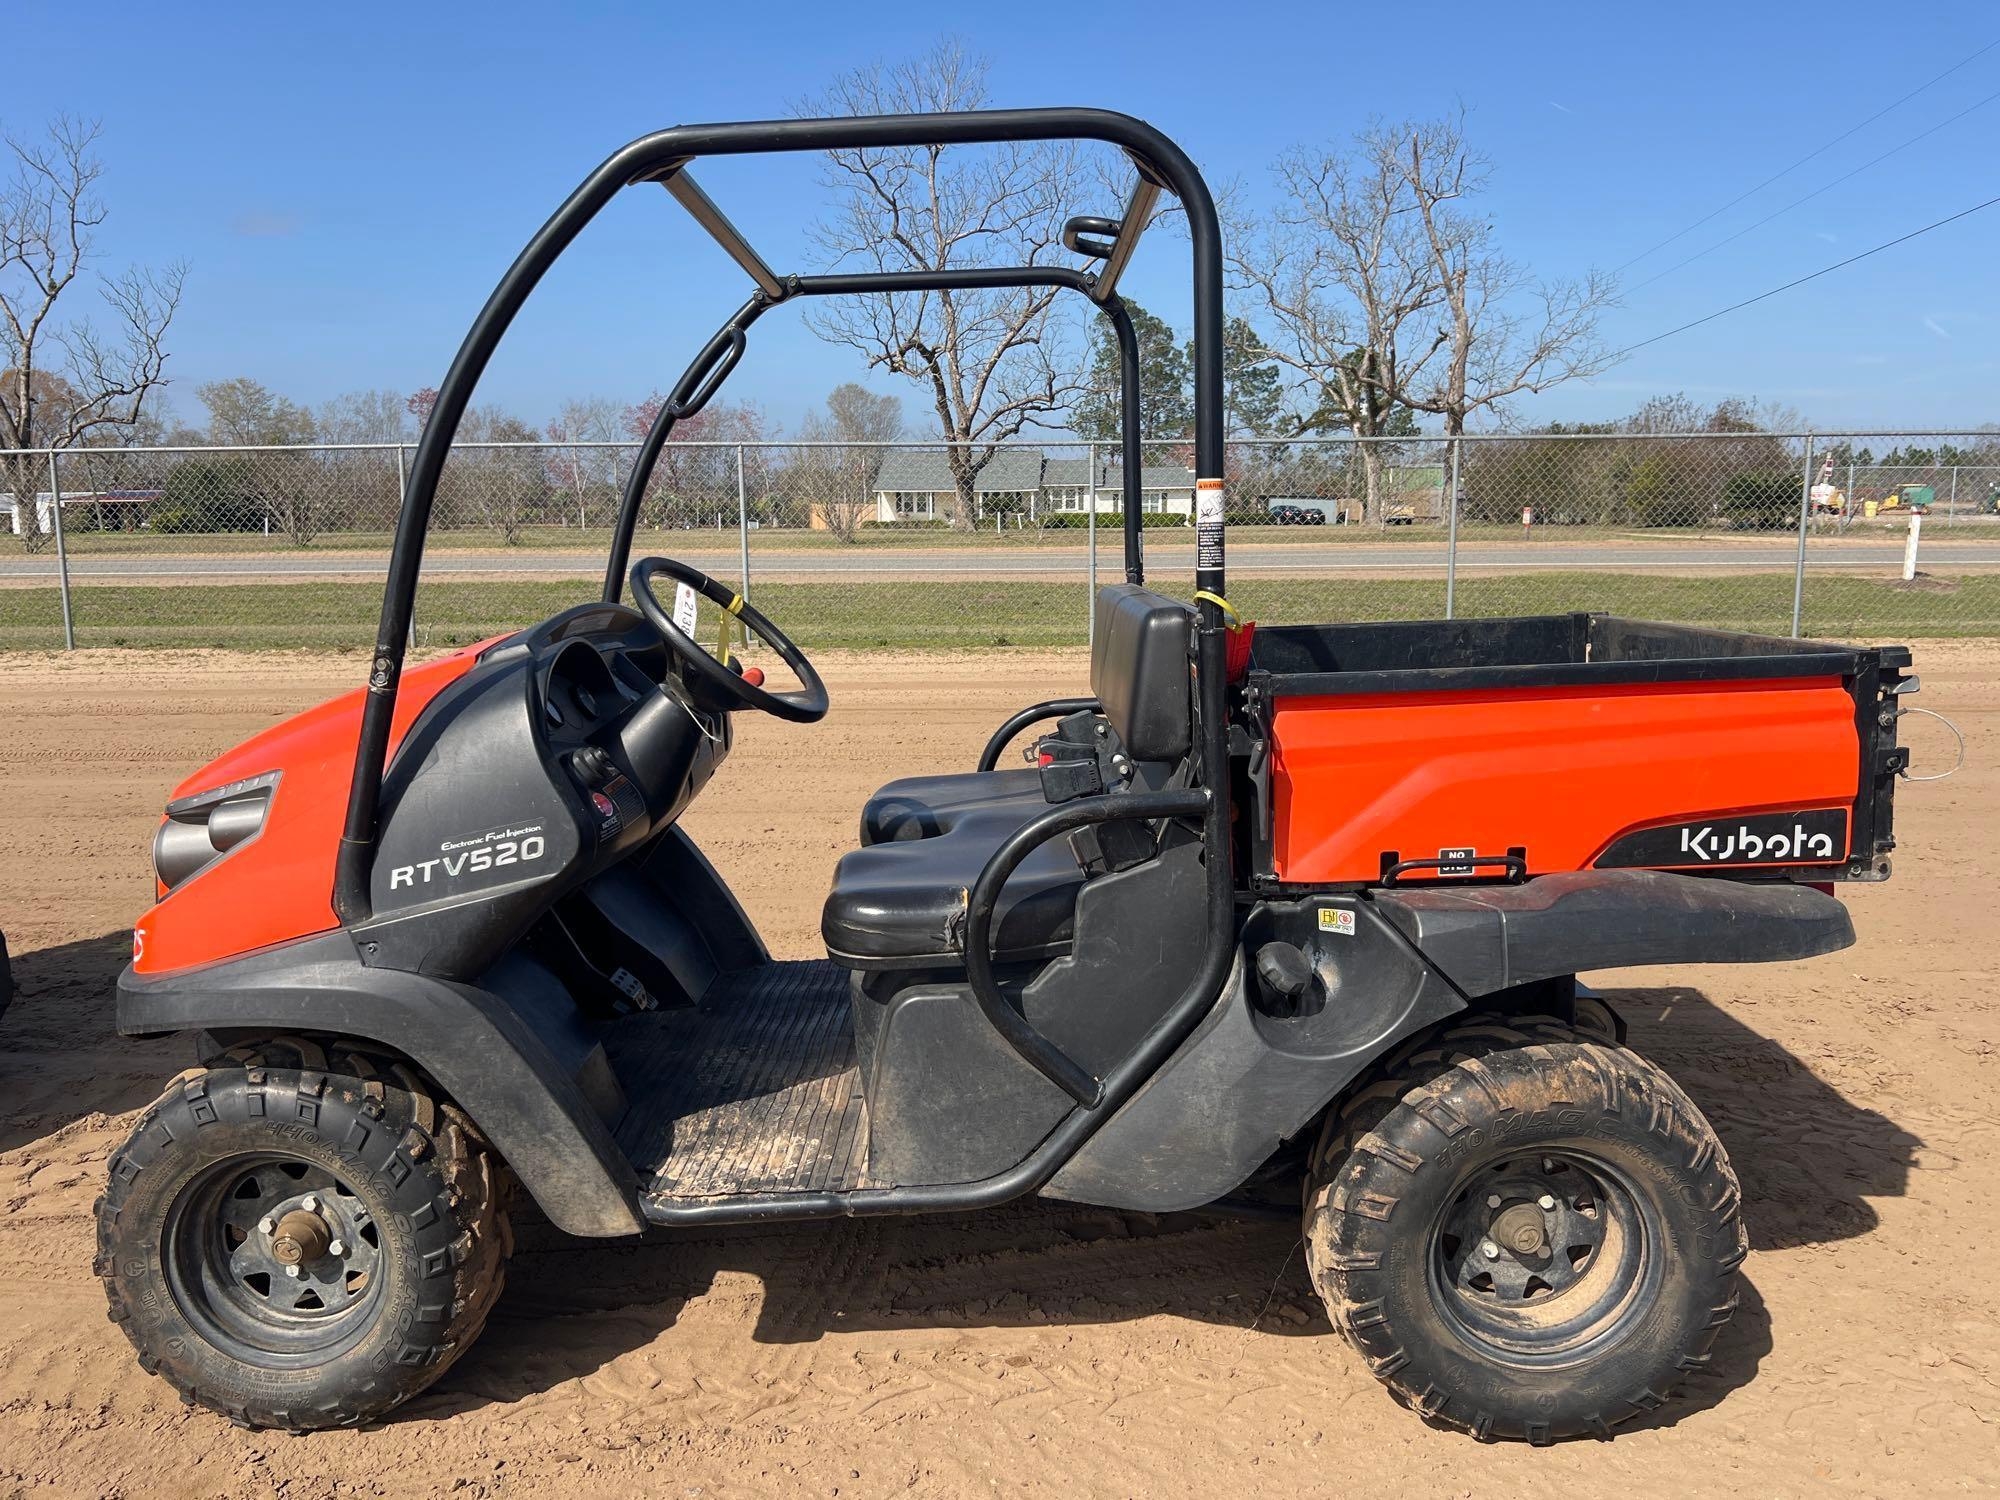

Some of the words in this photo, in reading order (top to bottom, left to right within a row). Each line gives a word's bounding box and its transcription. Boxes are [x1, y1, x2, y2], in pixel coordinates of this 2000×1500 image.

[441, 838, 485, 851] Electronic
[485, 832, 506, 842] Fuel
[506, 826, 542, 838] Injection
[1448, 851, 1465, 859] NO
[1681, 824, 1833, 860] Kubota
[390, 836, 545, 890] RTV520
[264, 1120, 320, 1144] 440
[320, 1141, 397, 1200] MAG
[392, 1213, 421, 1280] OFF
[372, 1284, 420, 1373] ROAD
